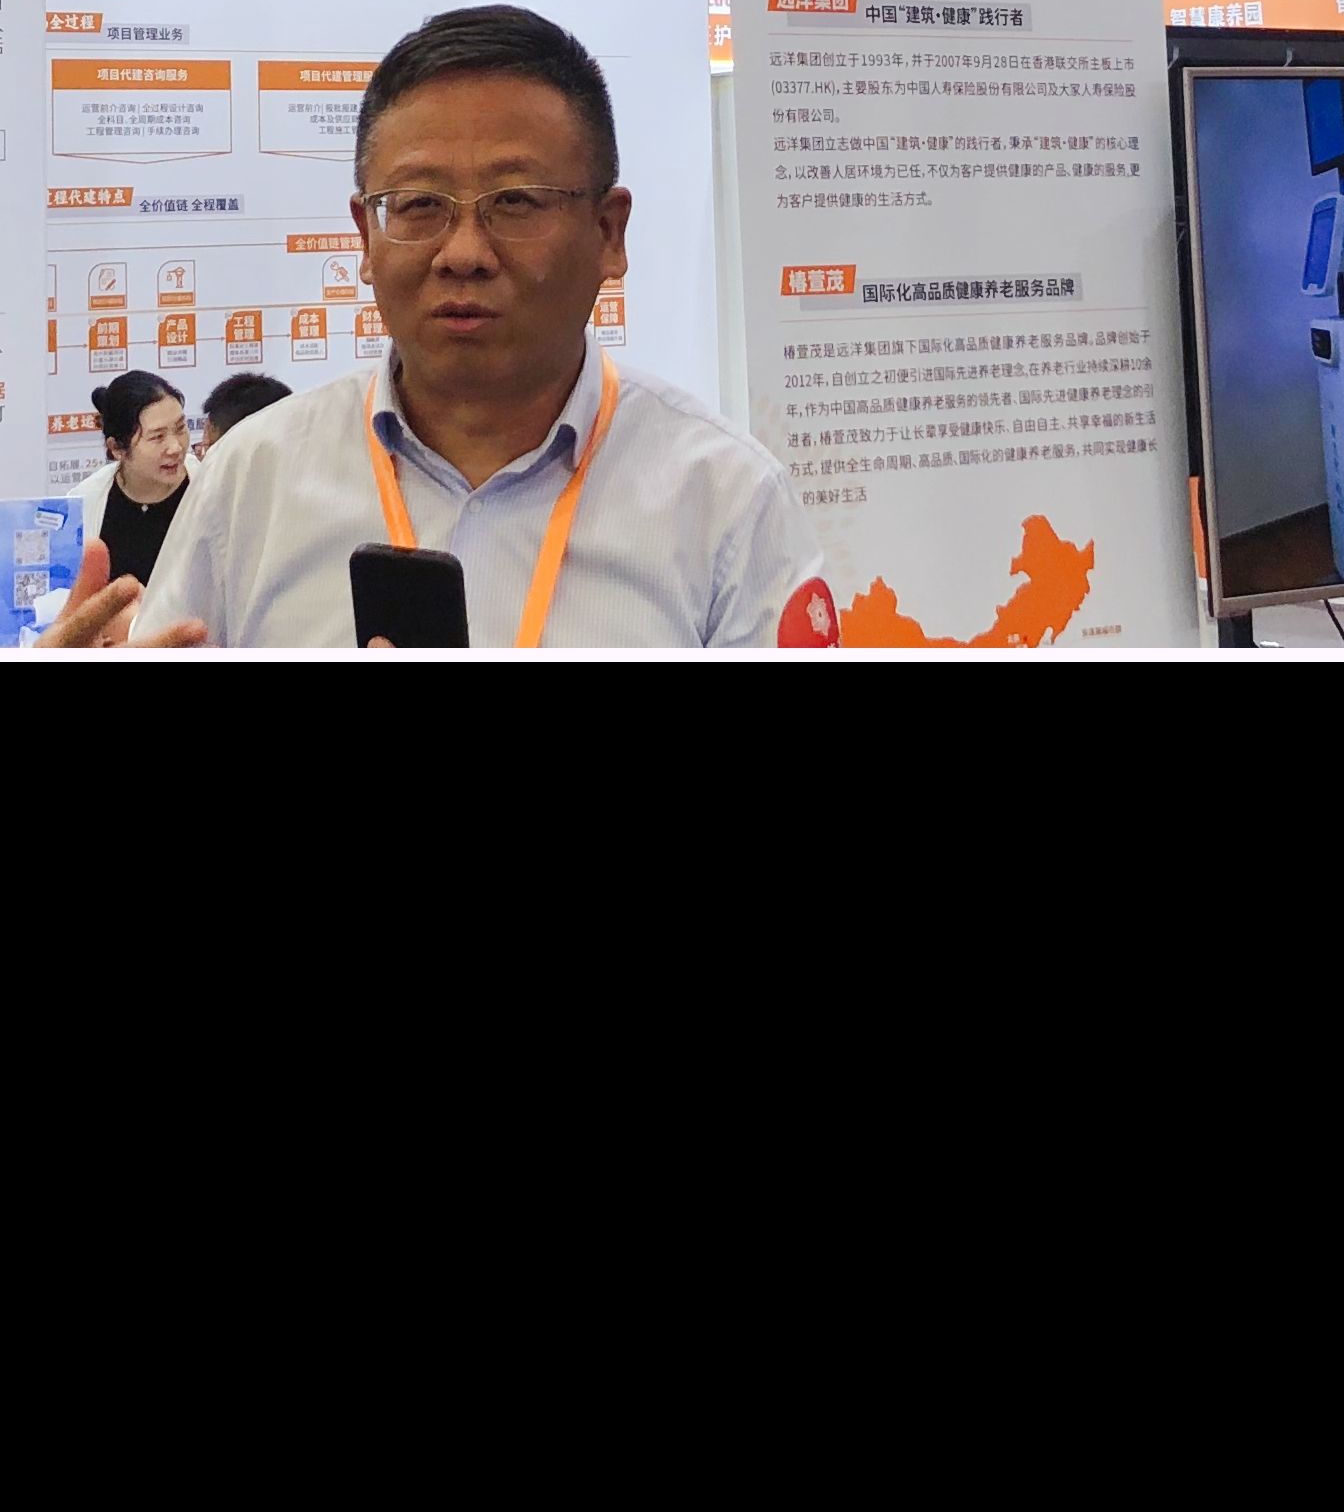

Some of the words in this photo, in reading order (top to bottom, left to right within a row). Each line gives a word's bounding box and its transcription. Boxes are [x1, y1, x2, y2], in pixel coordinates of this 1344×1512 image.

[46, 14, 95, 31] 全过程
[1169, 1, 1263, 27] 智慧康养园
[107, 27, 184, 42] 项目管理业务
[708, 24, 732, 47] 护
[97, 68, 189, 83] 项目代建咨询服务
[772, 107, 841, 124] 份有限公司。
[139, 199, 188, 213] 全价值链
[191, 198, 240, 212] 全程覆盖
[776, 191, 934, 210] 为客户提供健康的生活方式。
[788, 268, 845, 293] 椿萱茂
[862, 277, 1076, 304] 国际化高品质健康养老服务品牌
[52, 414, 102, 432] 养老运
